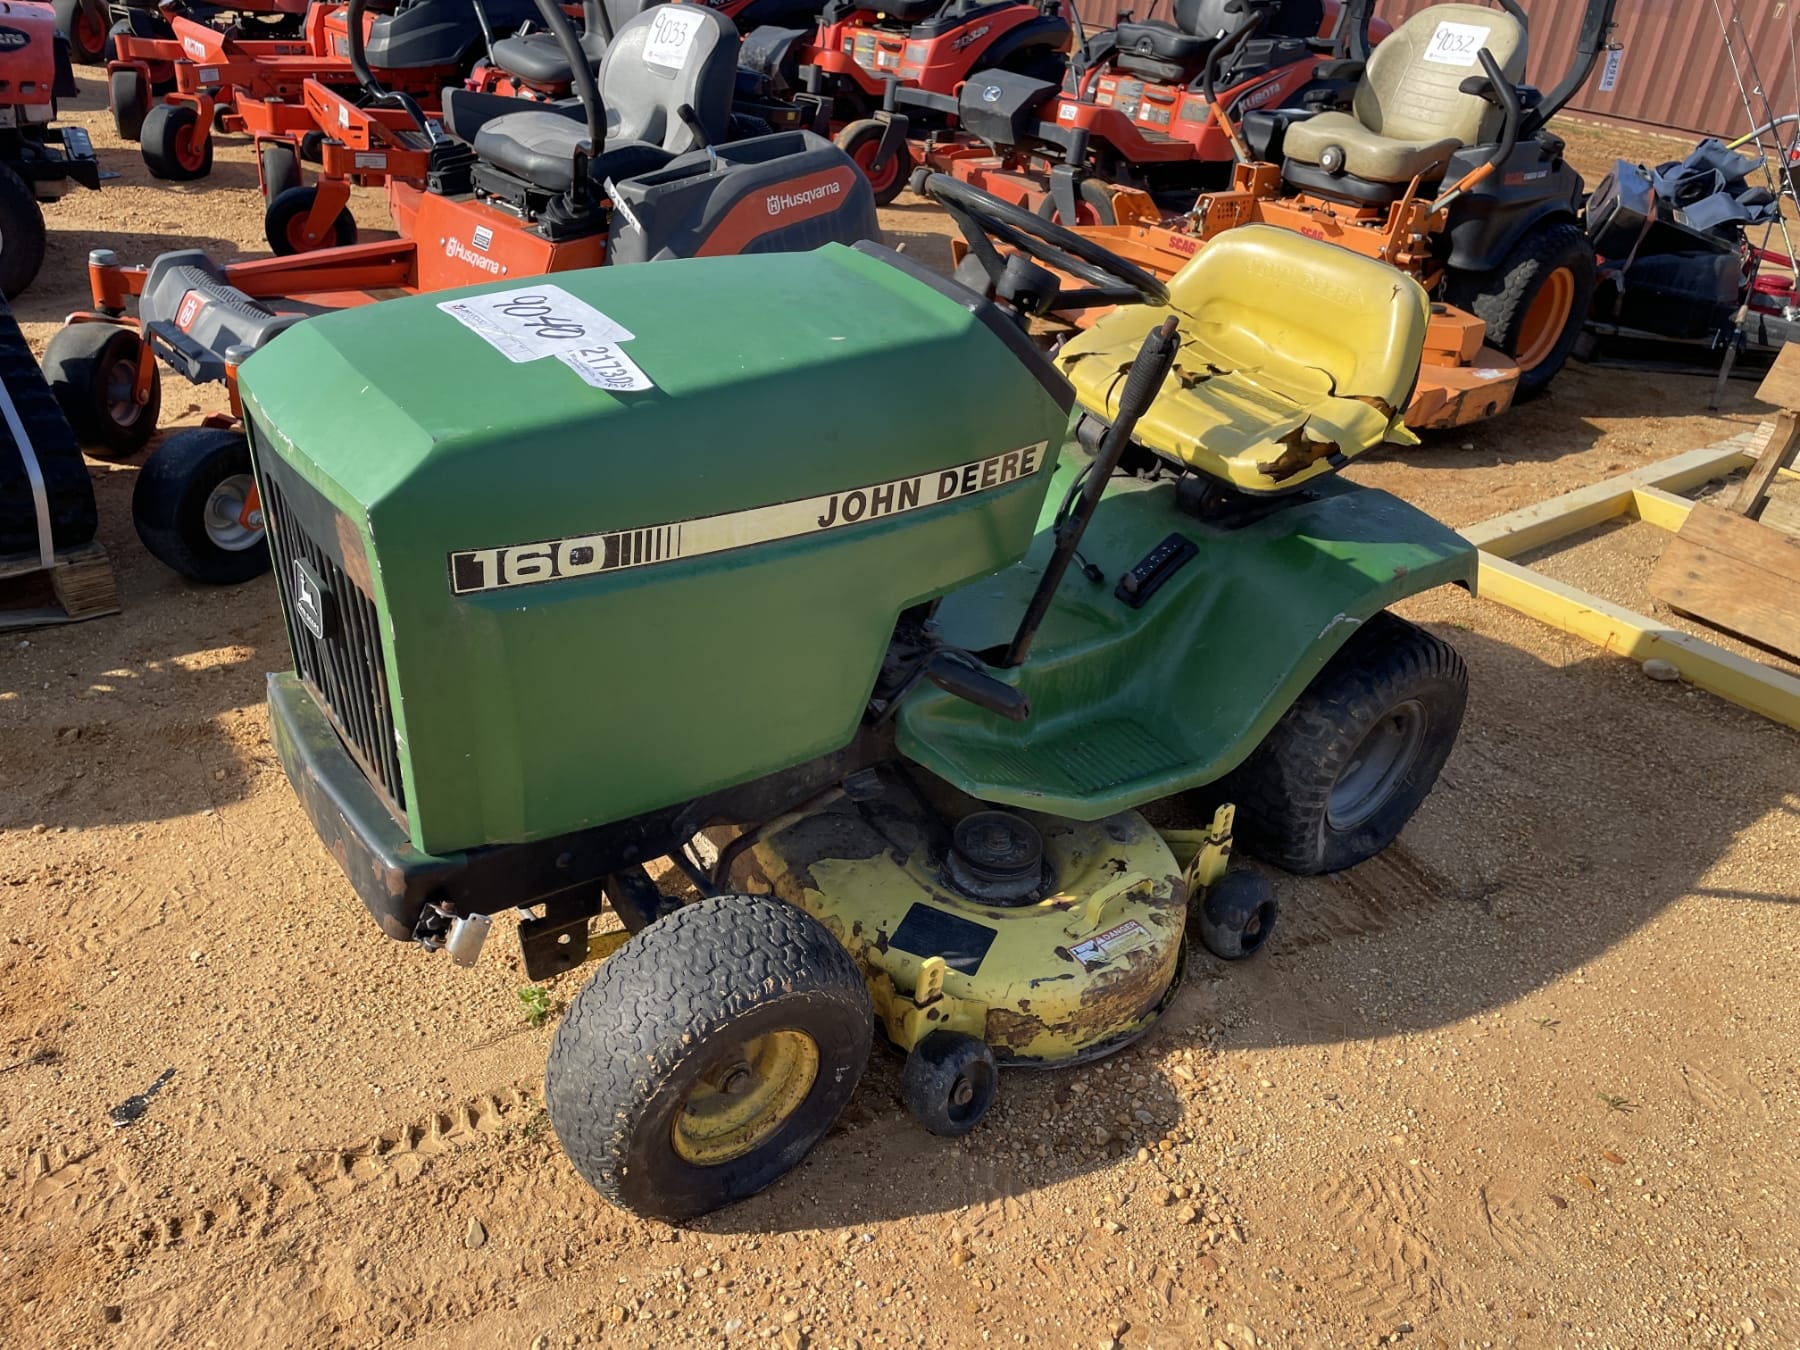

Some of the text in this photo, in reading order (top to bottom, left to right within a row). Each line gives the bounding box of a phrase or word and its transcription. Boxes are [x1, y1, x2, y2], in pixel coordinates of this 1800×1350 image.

[653, 12, 689, 47] 9033
[1436, 28, 1475, 53] 9032
[1238, 83, 1281, 111] KUBOTA
[779, 182, 840, 210] Husqvarna
[1168, 236, 1197, 255] SCAG
[1301, 227, 1324, 240] SCAG
[455, 241, 500, 275] Husqvarna
[493, 295, 586, 339] 9040
[579, 346, 635, 384] 21730
[817, 446, 1037, 528] JOHN DEERE
[472, 536, 606, 588] 160
[1103, 920, 1138, 941] DANGER
